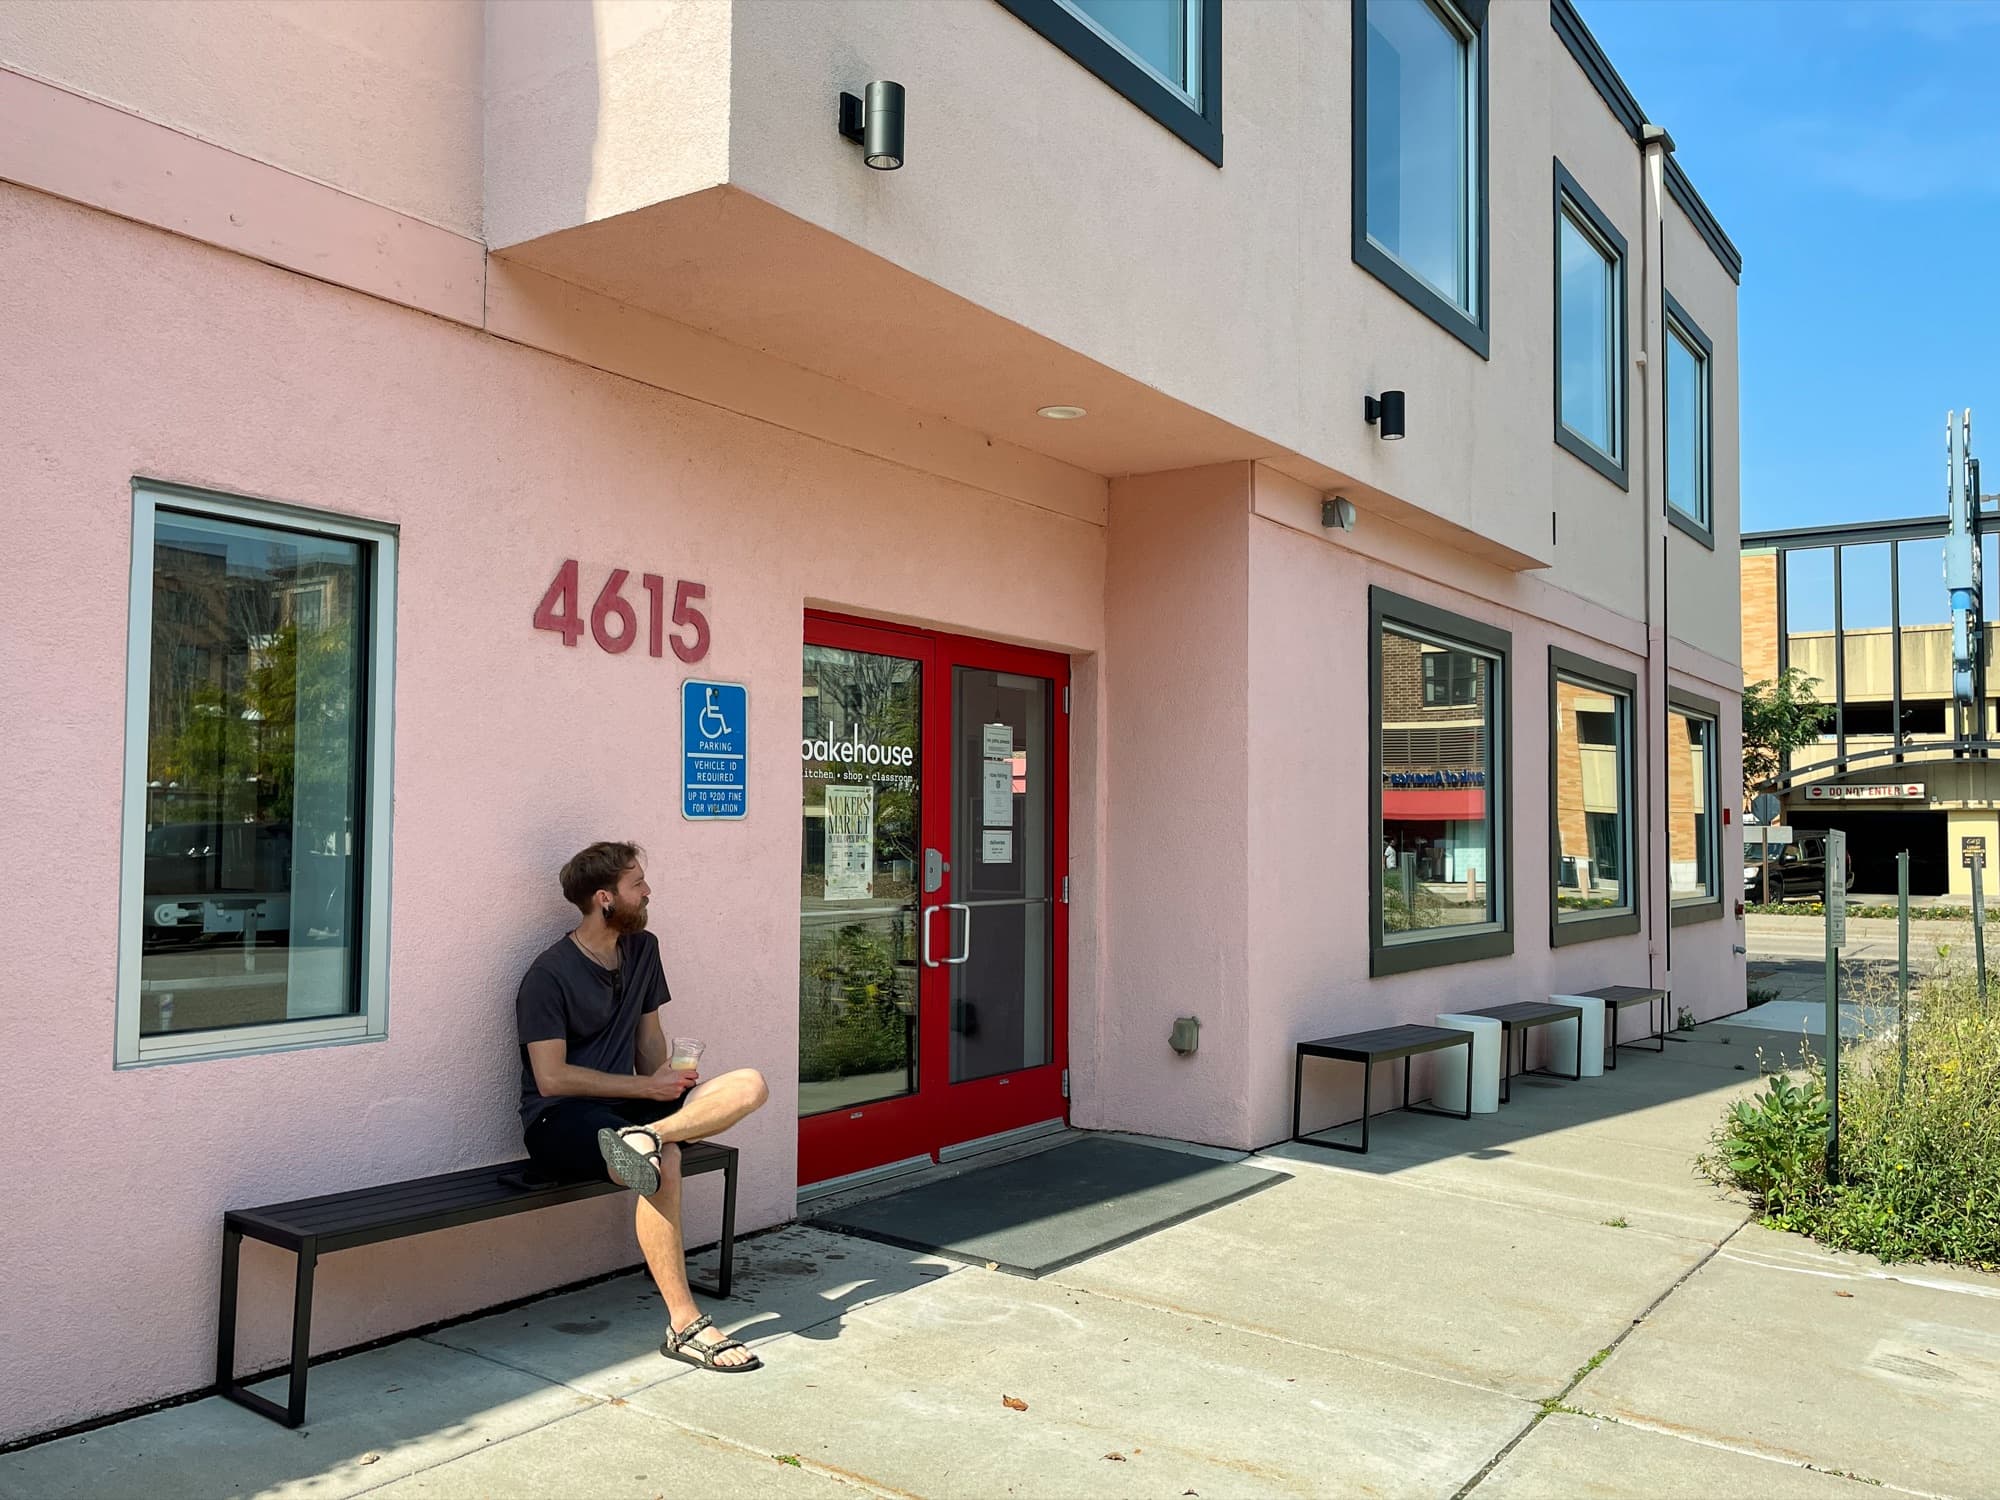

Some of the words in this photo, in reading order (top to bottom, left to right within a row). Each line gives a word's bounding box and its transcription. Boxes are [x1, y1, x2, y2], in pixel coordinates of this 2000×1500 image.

[533, 558, 710, 663] 4615
[699, 741, 732, 752] PARKING
[694, 760, 725, 771] VEHICLE
[729, 761, 737, 771] ID
[696, 772, 734, 782] REQUIRED
[801, 768, 834, 779] itchen
[843, 769, 863, 782] shop
[871, 772, 913, 782] classroom
[688, 791, 697, 801] UP
[699, 792, 707, 801] TO
[709, 792, 726, 801] $200
[728, 792, 743, 801] FINE
[1829, 787, 1842, 796] DO
[1845, 787, 1865, 796] NOT
[1868, 786, 1901, 796] ENTER
[692, 803, 705, 812] FOR
[828, 815, 870, 834] MARKET
